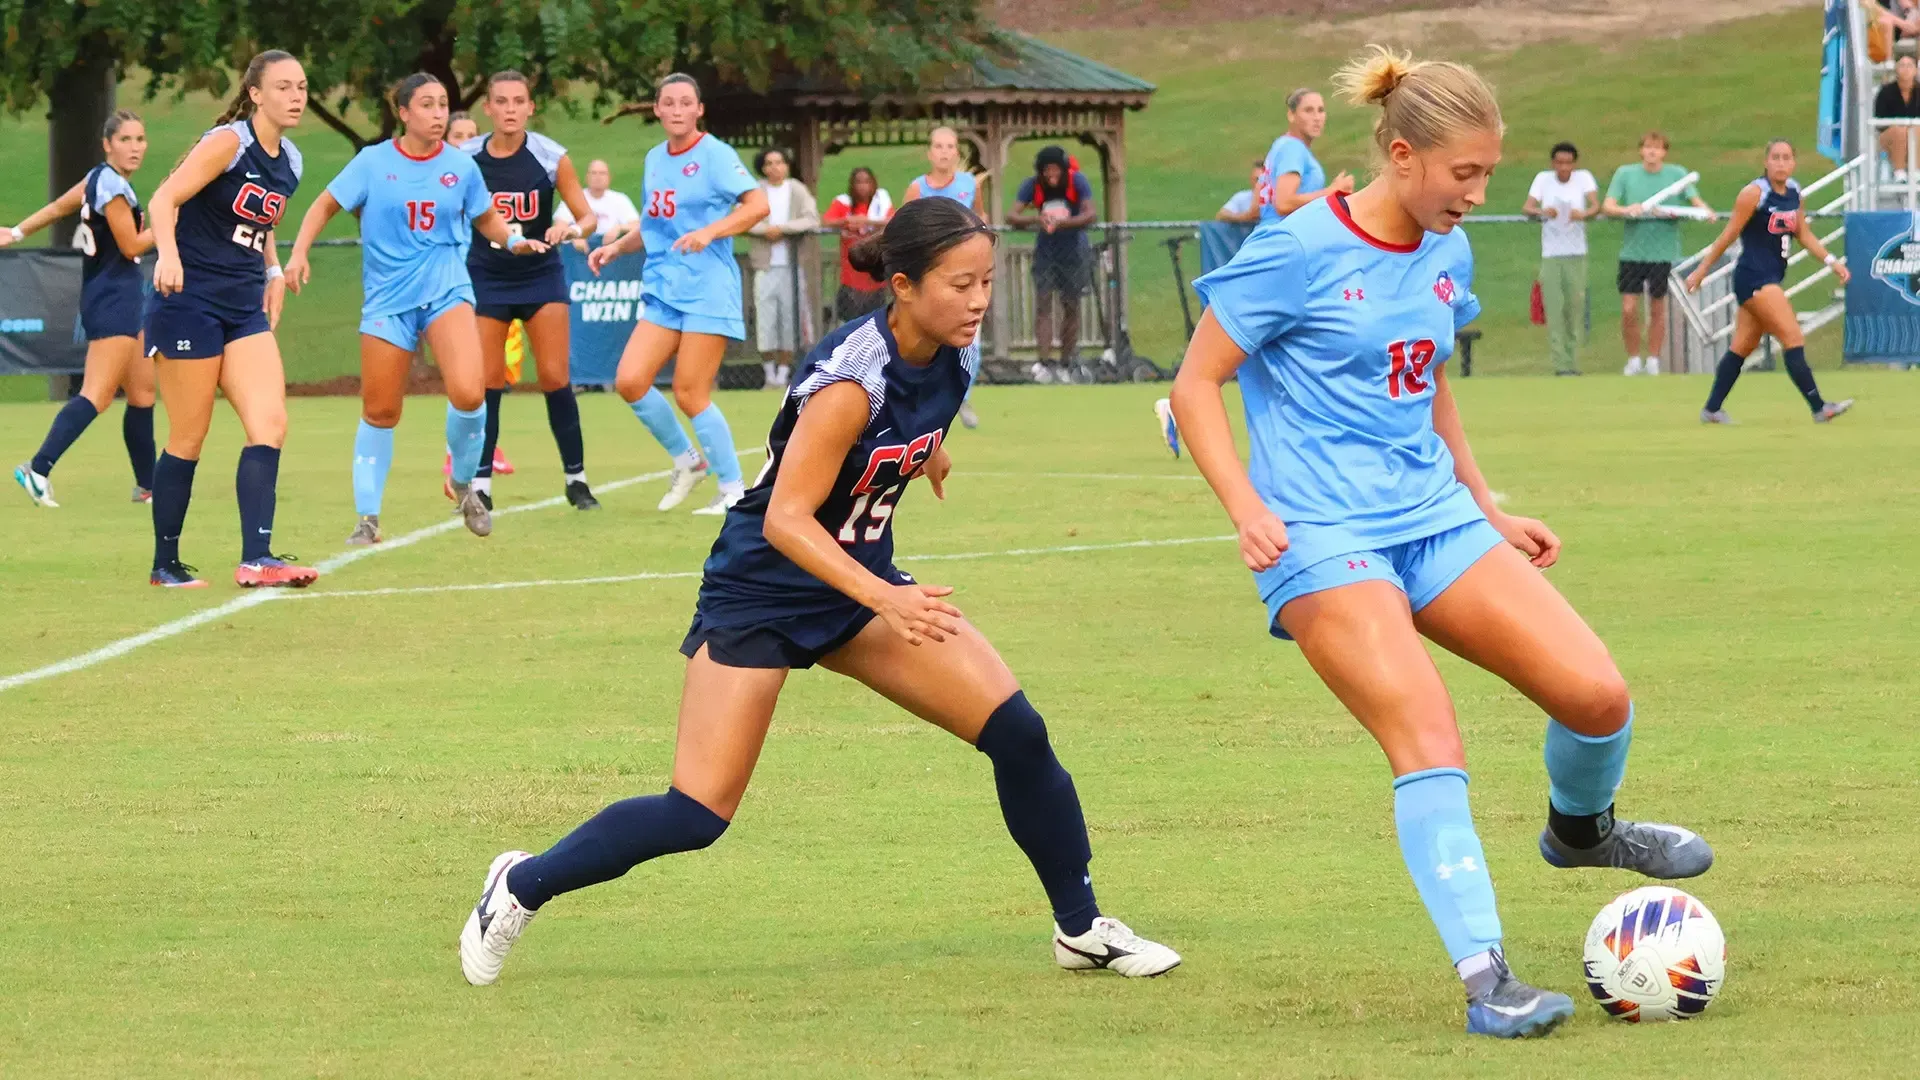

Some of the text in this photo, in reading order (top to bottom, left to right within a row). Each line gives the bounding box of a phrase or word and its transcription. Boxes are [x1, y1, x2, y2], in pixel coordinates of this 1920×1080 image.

[405, 200, 435, 232] 15
[489, 188, 539, 221] SU
[647, 189, 677, 219] 35
[570, 280, 644, 301] CHAM
[581, 301, 631, 321] WIN
[176, 339, 191, 351] 22
[837, 484, 899, 544] 15
